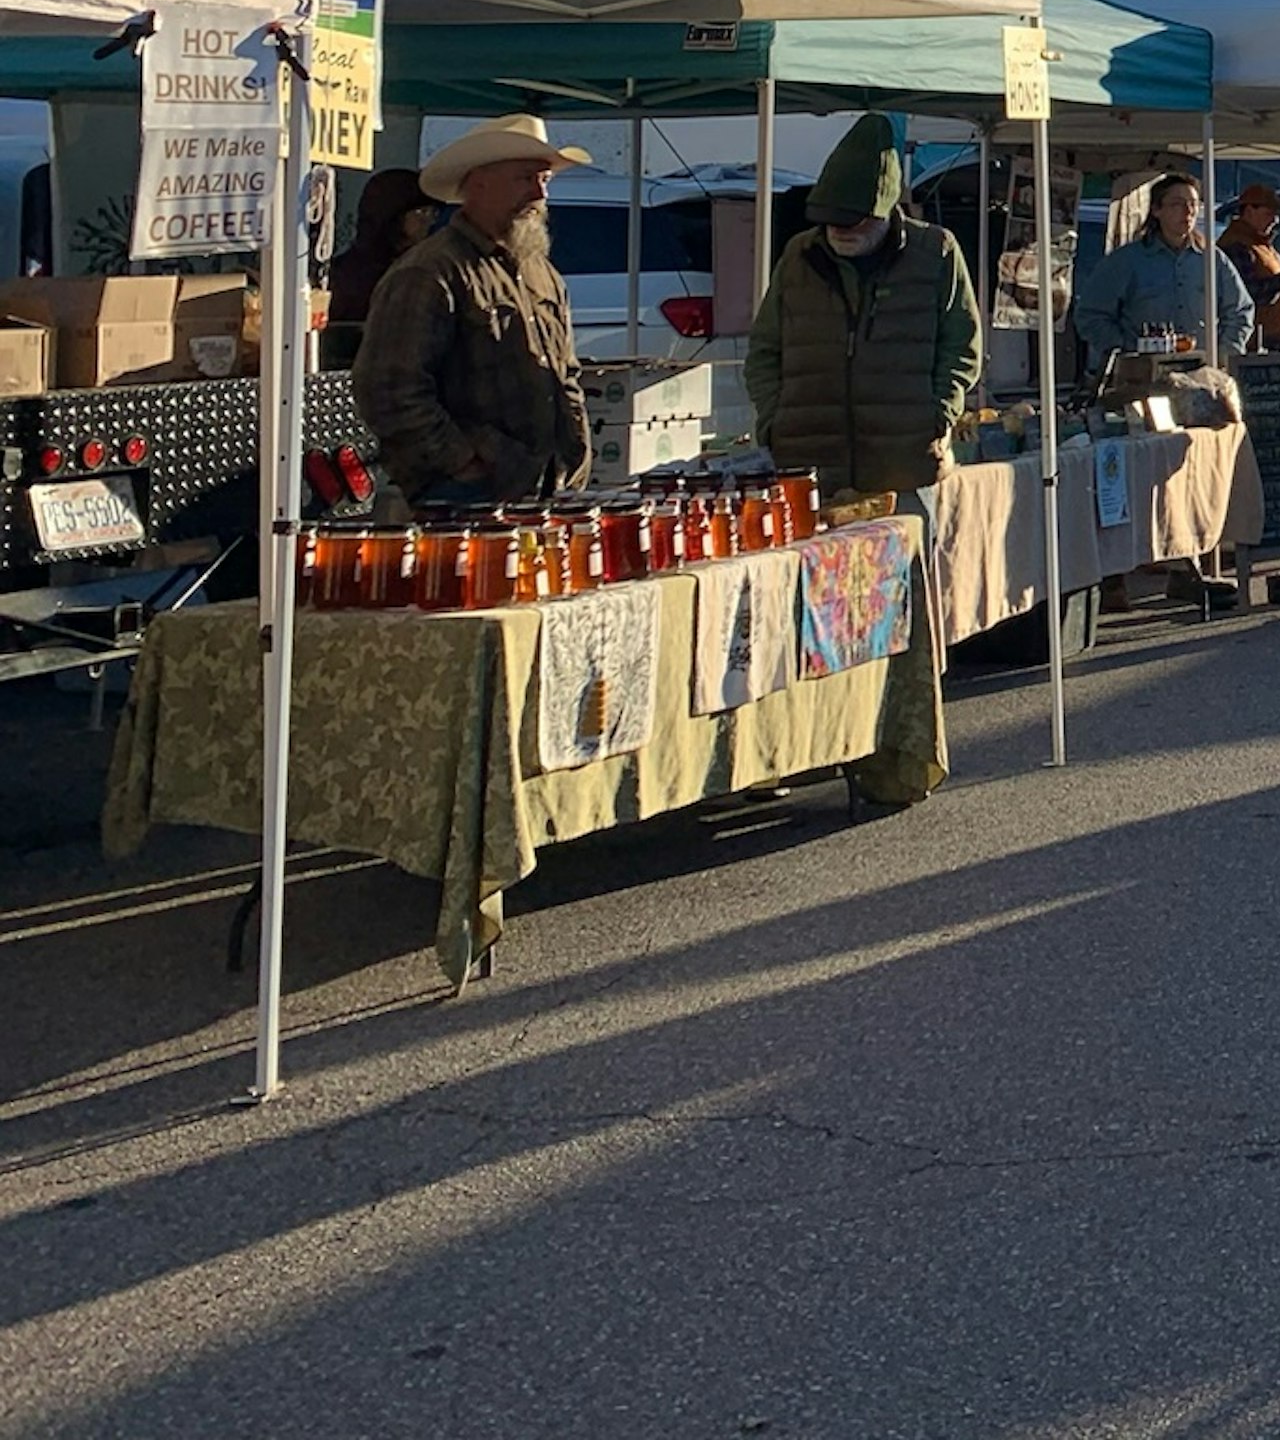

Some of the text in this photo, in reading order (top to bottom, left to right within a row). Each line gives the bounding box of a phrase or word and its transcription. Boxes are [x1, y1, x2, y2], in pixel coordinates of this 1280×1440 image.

[183, 29, 239, 54] HOT
[156, 73, 268, 101] DRINKS!
[164, 137, 265, 159] WE Make
[157, 172, 265, 197] AMAZING
[149, 209, 265, 242] COFFEE!
